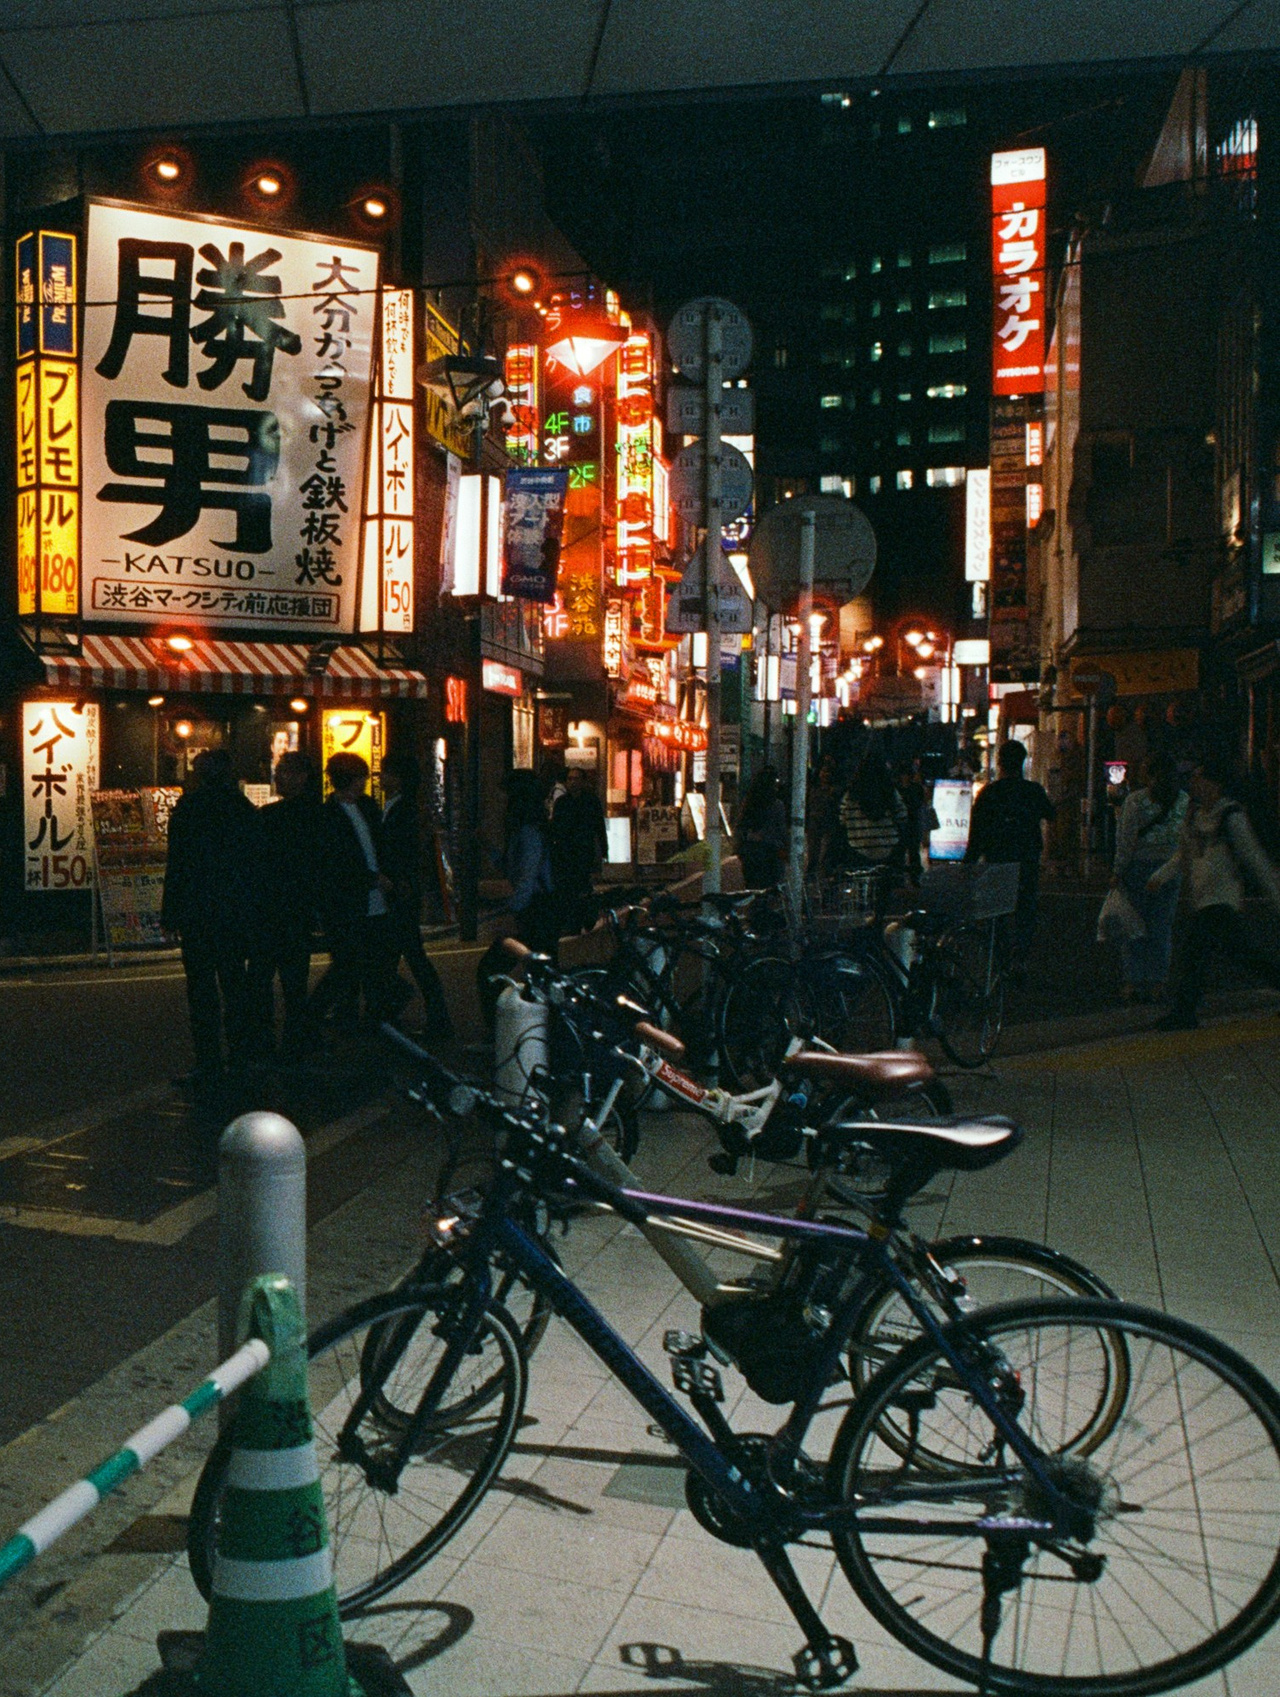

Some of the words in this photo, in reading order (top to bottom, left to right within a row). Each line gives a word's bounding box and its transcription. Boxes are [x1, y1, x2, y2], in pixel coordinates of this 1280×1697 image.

[998, 202, 1040, 352] カラオケ
[95, 237, 302, 555] 勝男
[295, 256, 361, 587] 大分からあげと鉄板焼
[545, 411, 569, 434] 4F
[42, 366, 76, 528] プレモル
[544, 436, 569, 460] 3F
[569, 464, 595, 489] 2F
[384, 407, 410, 558] ハイボール
[102, 581, 332, 618] 渋谷マークシティ前応援団
[543, 613, 568, 637] 1F
[571, 574, 597, 635] 渋谷苑
[29, 708, 76, 851] ハイボール
[661, 1063, 704, 1096] Supreme
